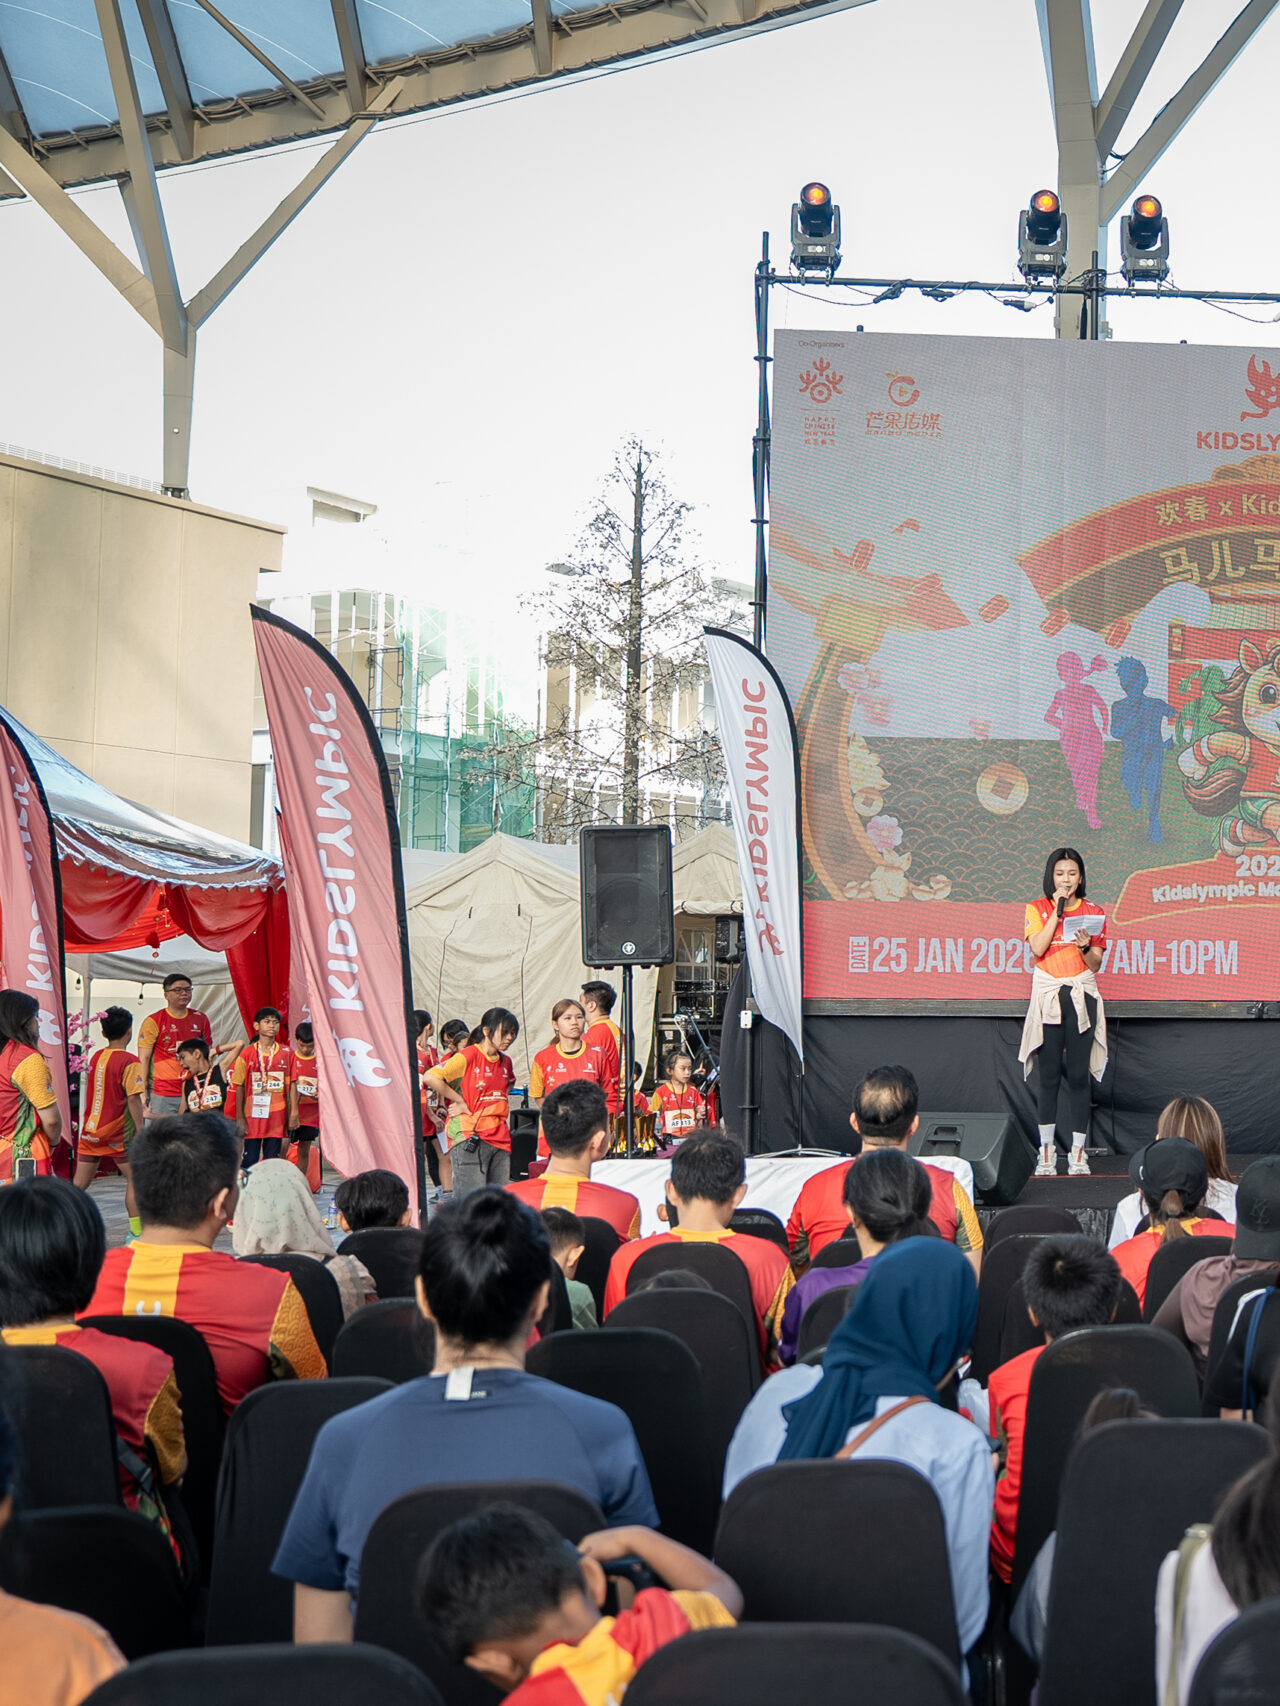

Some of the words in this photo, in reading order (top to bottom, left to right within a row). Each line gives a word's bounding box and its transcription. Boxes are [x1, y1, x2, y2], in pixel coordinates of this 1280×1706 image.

[1152, 880, 1255, 903] Kidslympic
[850, 939, 867, 970] DATE
[872, 936, 908, 973] 25
[914, 937, 963, 973] JAN
